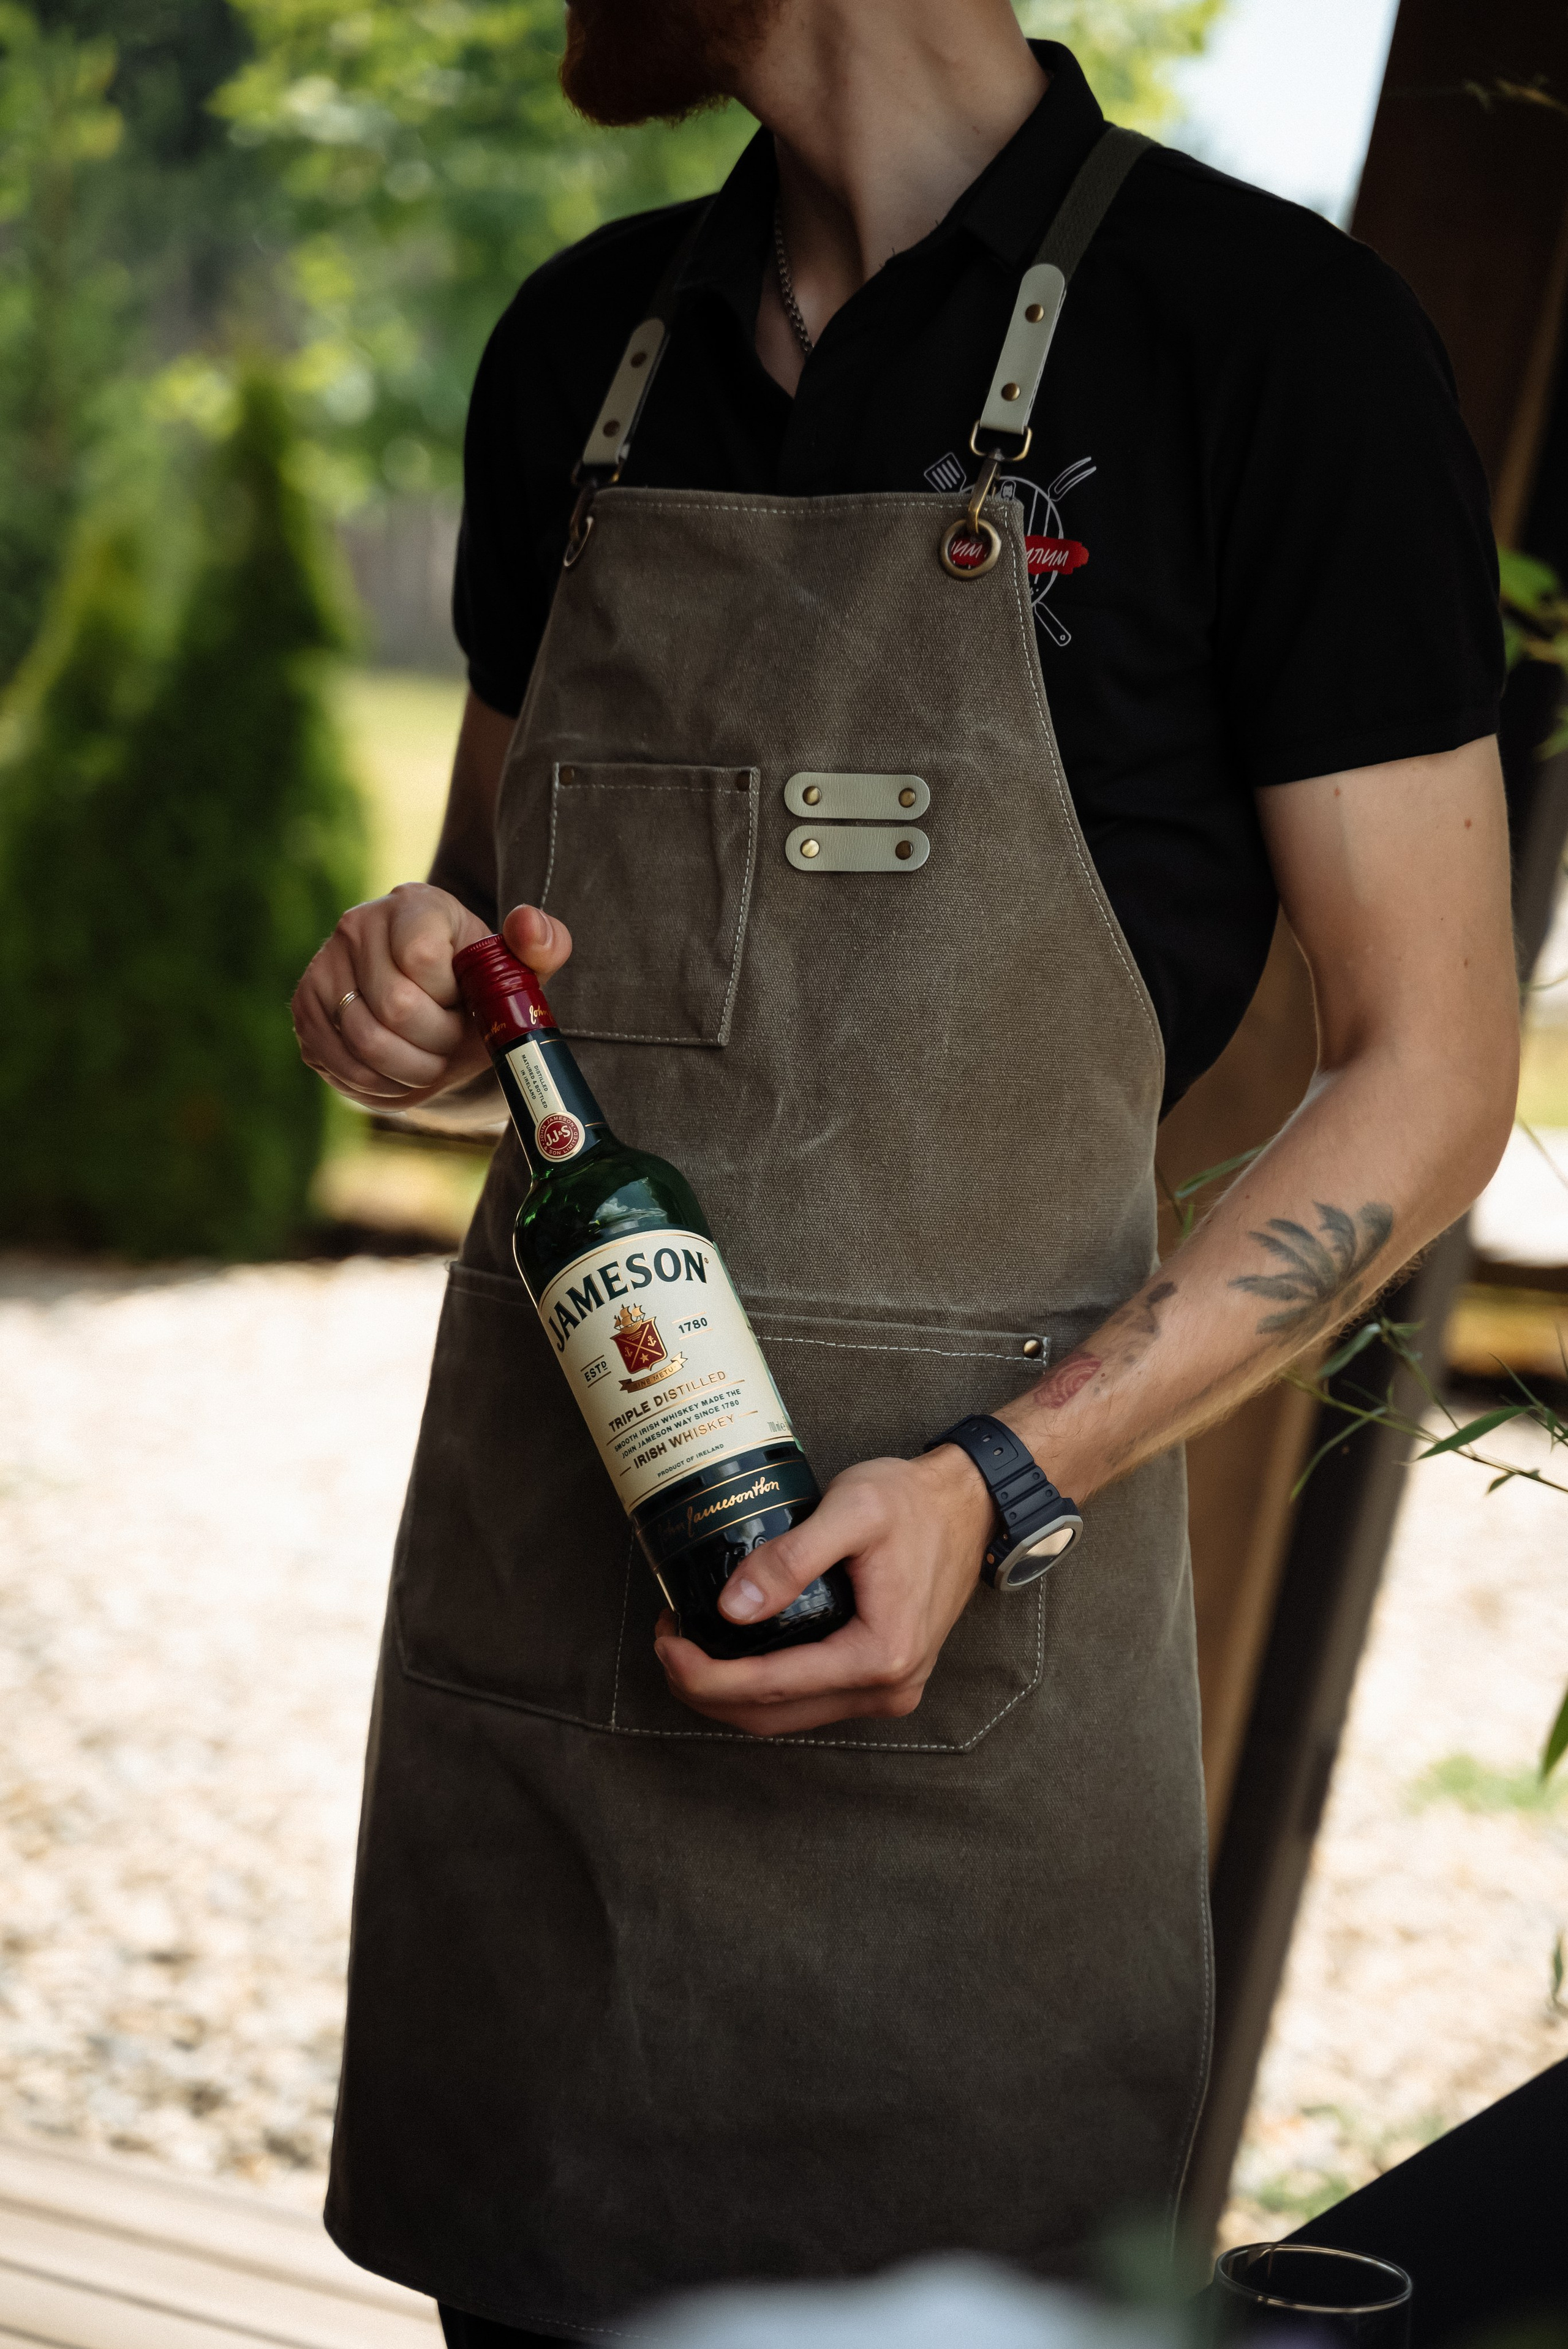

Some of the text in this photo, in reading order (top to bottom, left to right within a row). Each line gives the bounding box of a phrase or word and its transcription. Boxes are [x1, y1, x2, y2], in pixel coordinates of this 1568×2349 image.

[521, 1054, 535, 1079] MATURED
[535, 1085, 548, 1109] BOTTLED
[524, 1076, 536, 1100] IRELAND
[534, 1065, 548, 1092] DISTILLED
[547, 1116, 575, 1128] JAMESON
[563, 1131, 578, 1153] LIMITED
[548, 1248, 707, 1353] JAMESON
[678, 1317, 708, 1334] 1780
[584, 1360, 608, 1382] ESTD
[633, 1367, 674, 1389] SINE METU
[608, 1371, 726, 1433] TRIPLE DISTILLED
[614, 1389, 741, 1452] SMOOTH IRISH WHISKEY MADE THE
[622, 1399, 739, 1459] JOHN JAMESON WAY SINCE 1780
[633, 1414, 734, 1469] IRISH WHISKEY
[657, 1460, 685, 1477] PRODUCT
[696, 1443, 724, 1459] IRELAND
